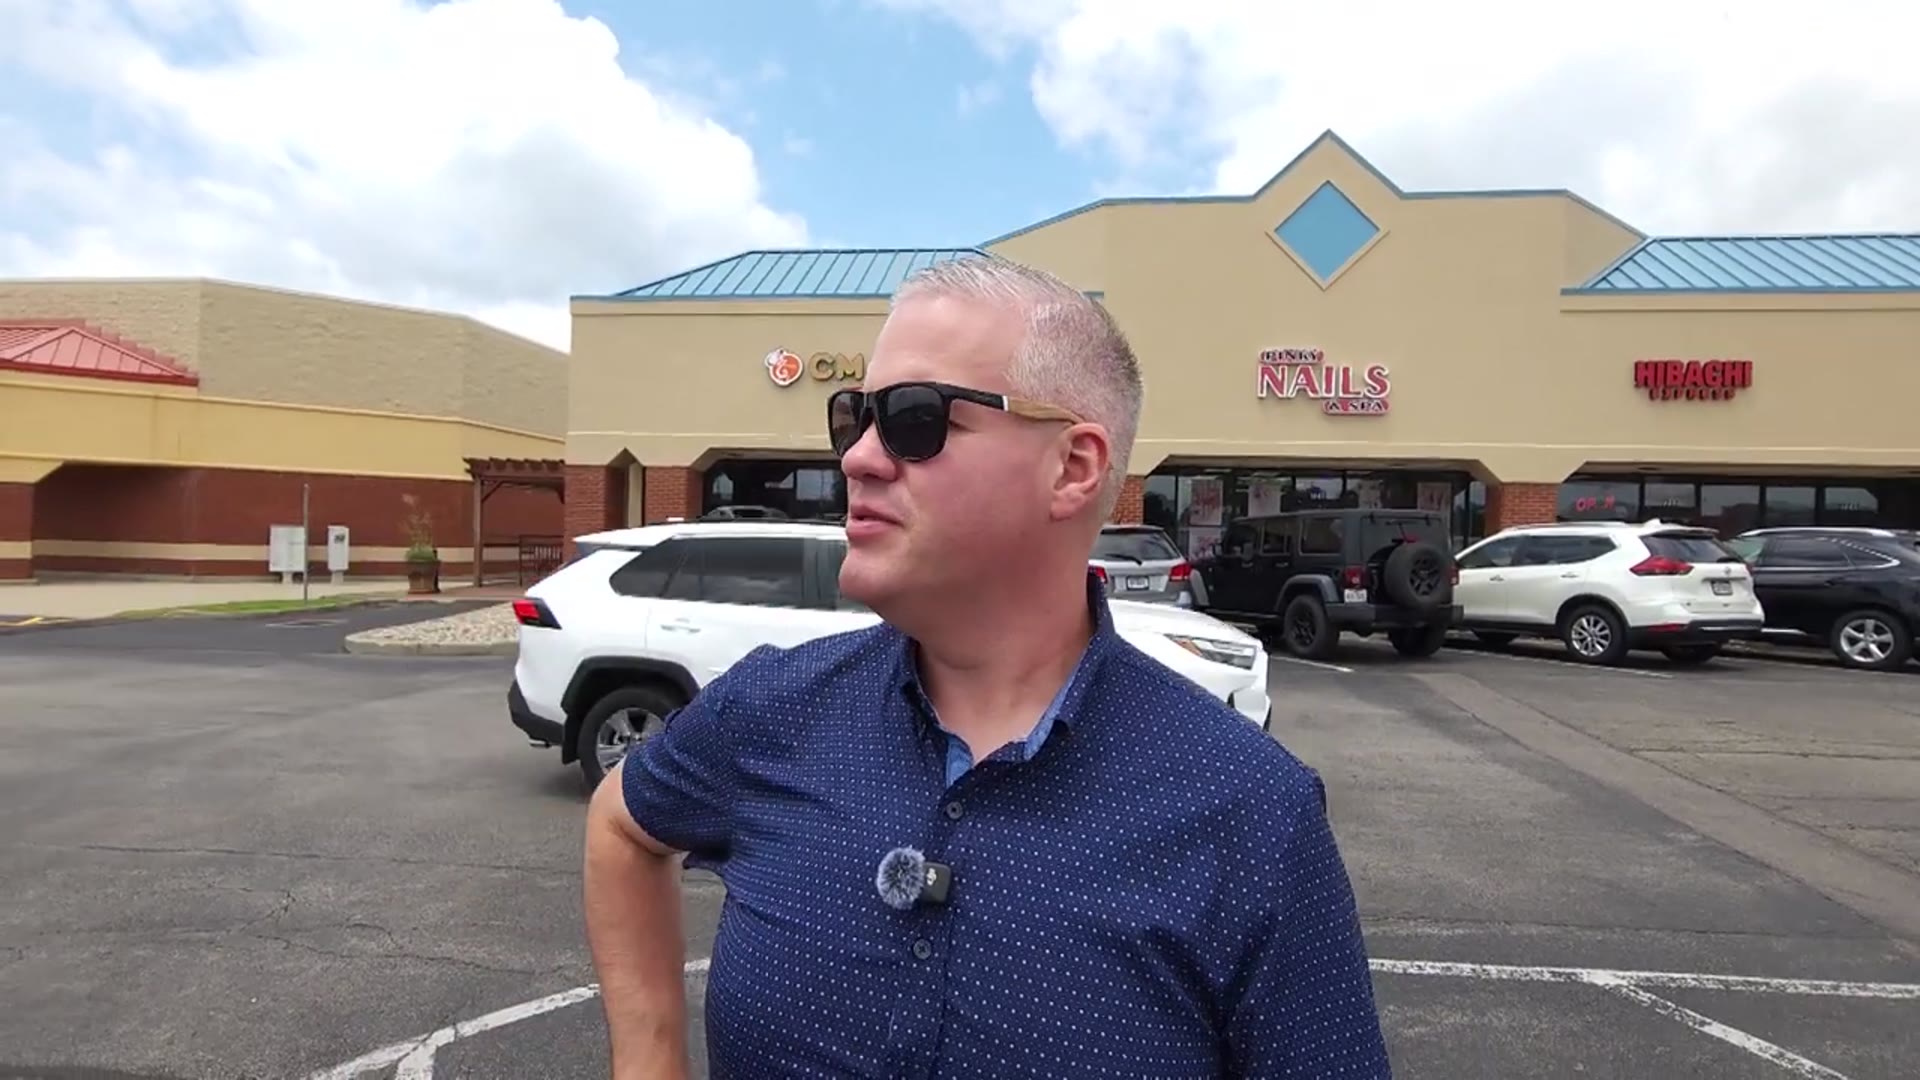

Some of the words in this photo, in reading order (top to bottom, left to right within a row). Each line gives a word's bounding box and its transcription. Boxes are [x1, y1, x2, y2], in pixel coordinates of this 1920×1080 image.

[1263, 349, 1319, 362] PINKY
[1257, 364, 1391, 399] NAILS
[1634, 360, 1753, 388] HIBACHI
[1348, 399, 1384, 412] SPA
